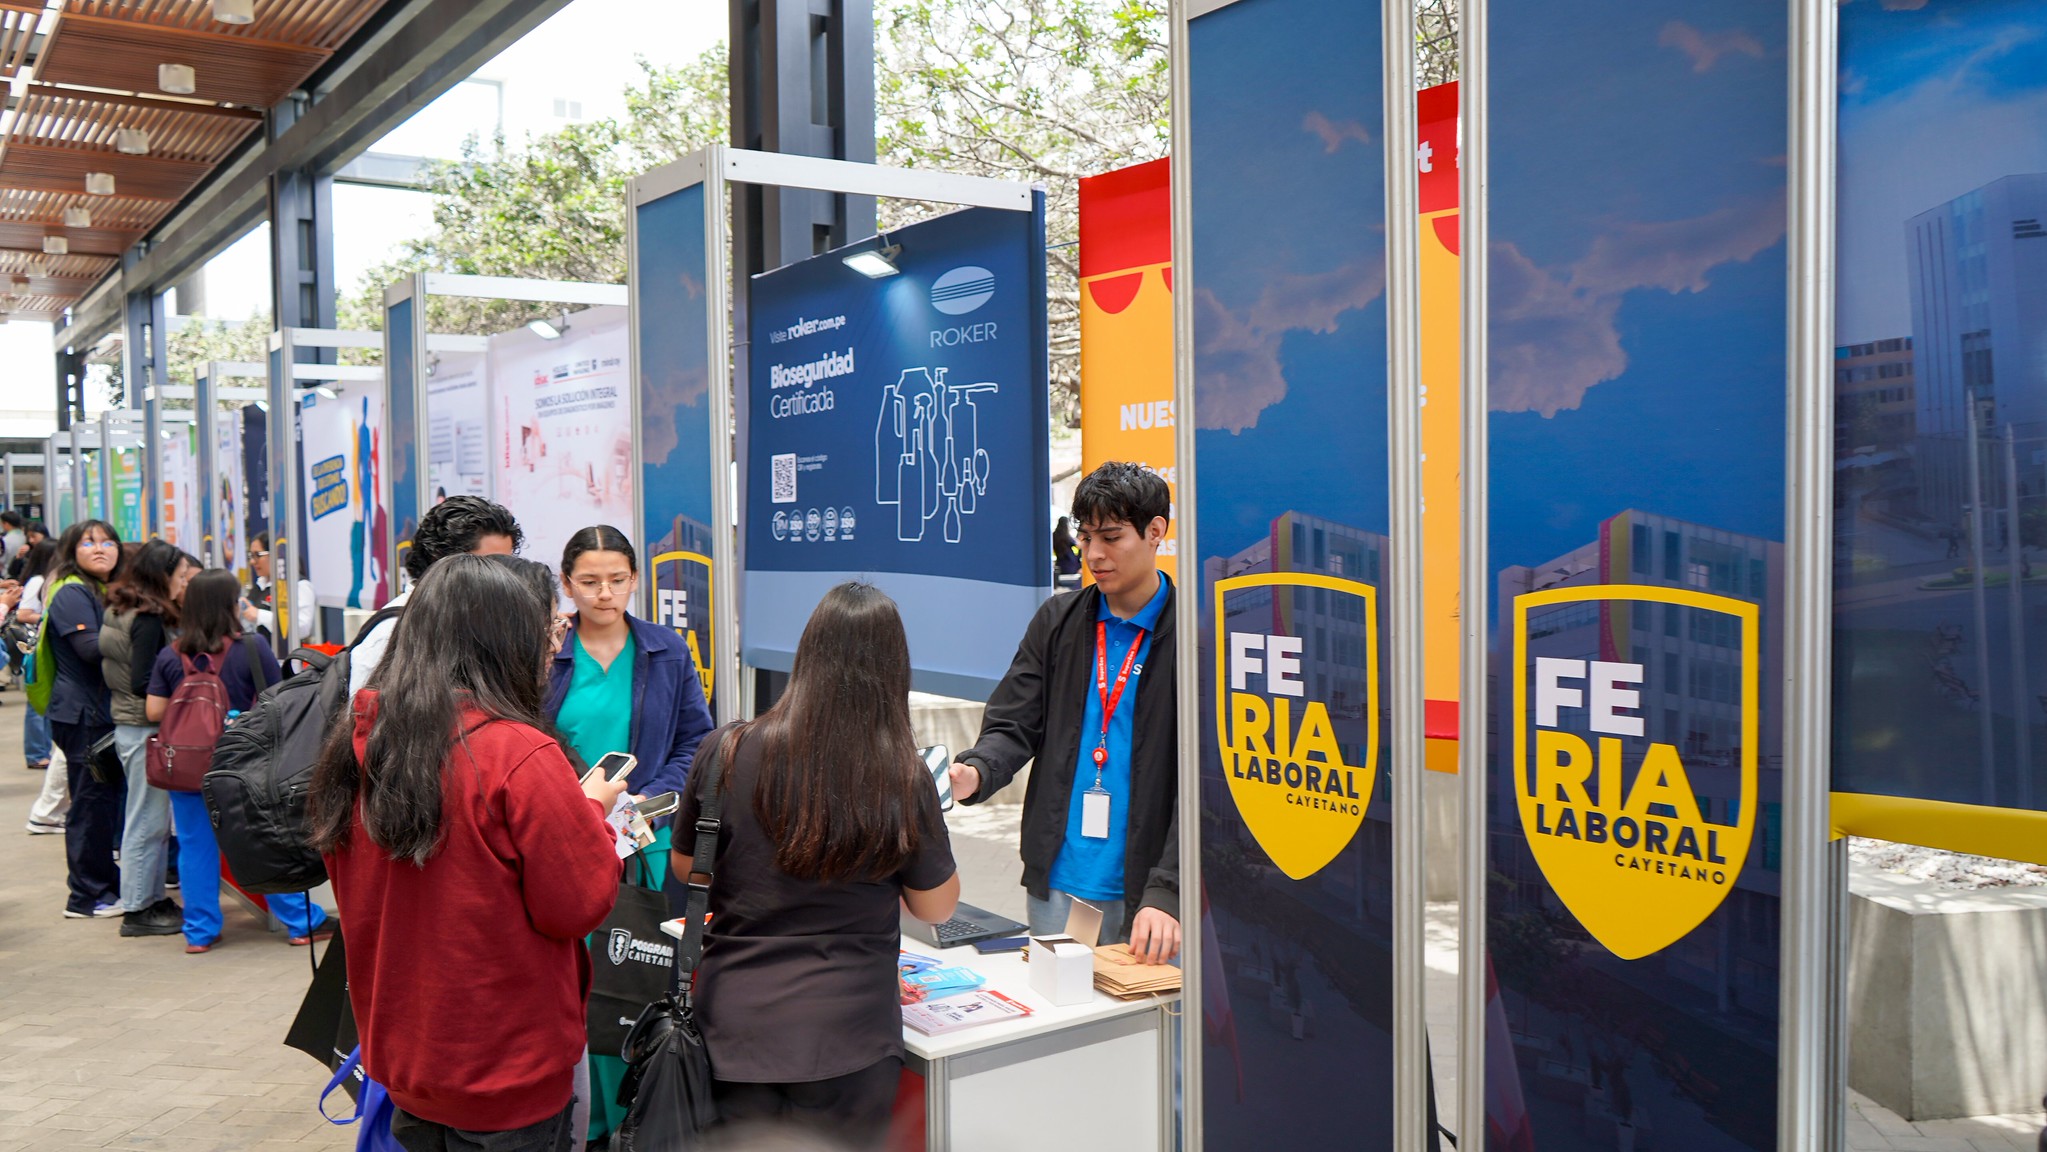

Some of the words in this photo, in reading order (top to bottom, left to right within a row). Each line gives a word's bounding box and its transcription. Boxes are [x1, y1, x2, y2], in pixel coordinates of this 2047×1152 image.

[787, 315, 846, 340] roker.com.pe
[930, 322, 997, 348] ROKER
[770, 347, 854, 389] Bioseguridad
[770, 385, 834, 418] Certificada
[658, 589, 687, 627] FE
[1230, 631, 1304, 697] FE
[1536, 657, 1644, 737] FE
[1231, 692, 1344, 767] RIA
[1233, 752, 1360, 800] LABORAL
[1536, 729, 1705, 824] RIA
[1286, 793, 1360, 816] CAYETANO
[1536, 803, 1726, 865] LABORAL
[1614, 853, 1726, 885] CAYETANO
